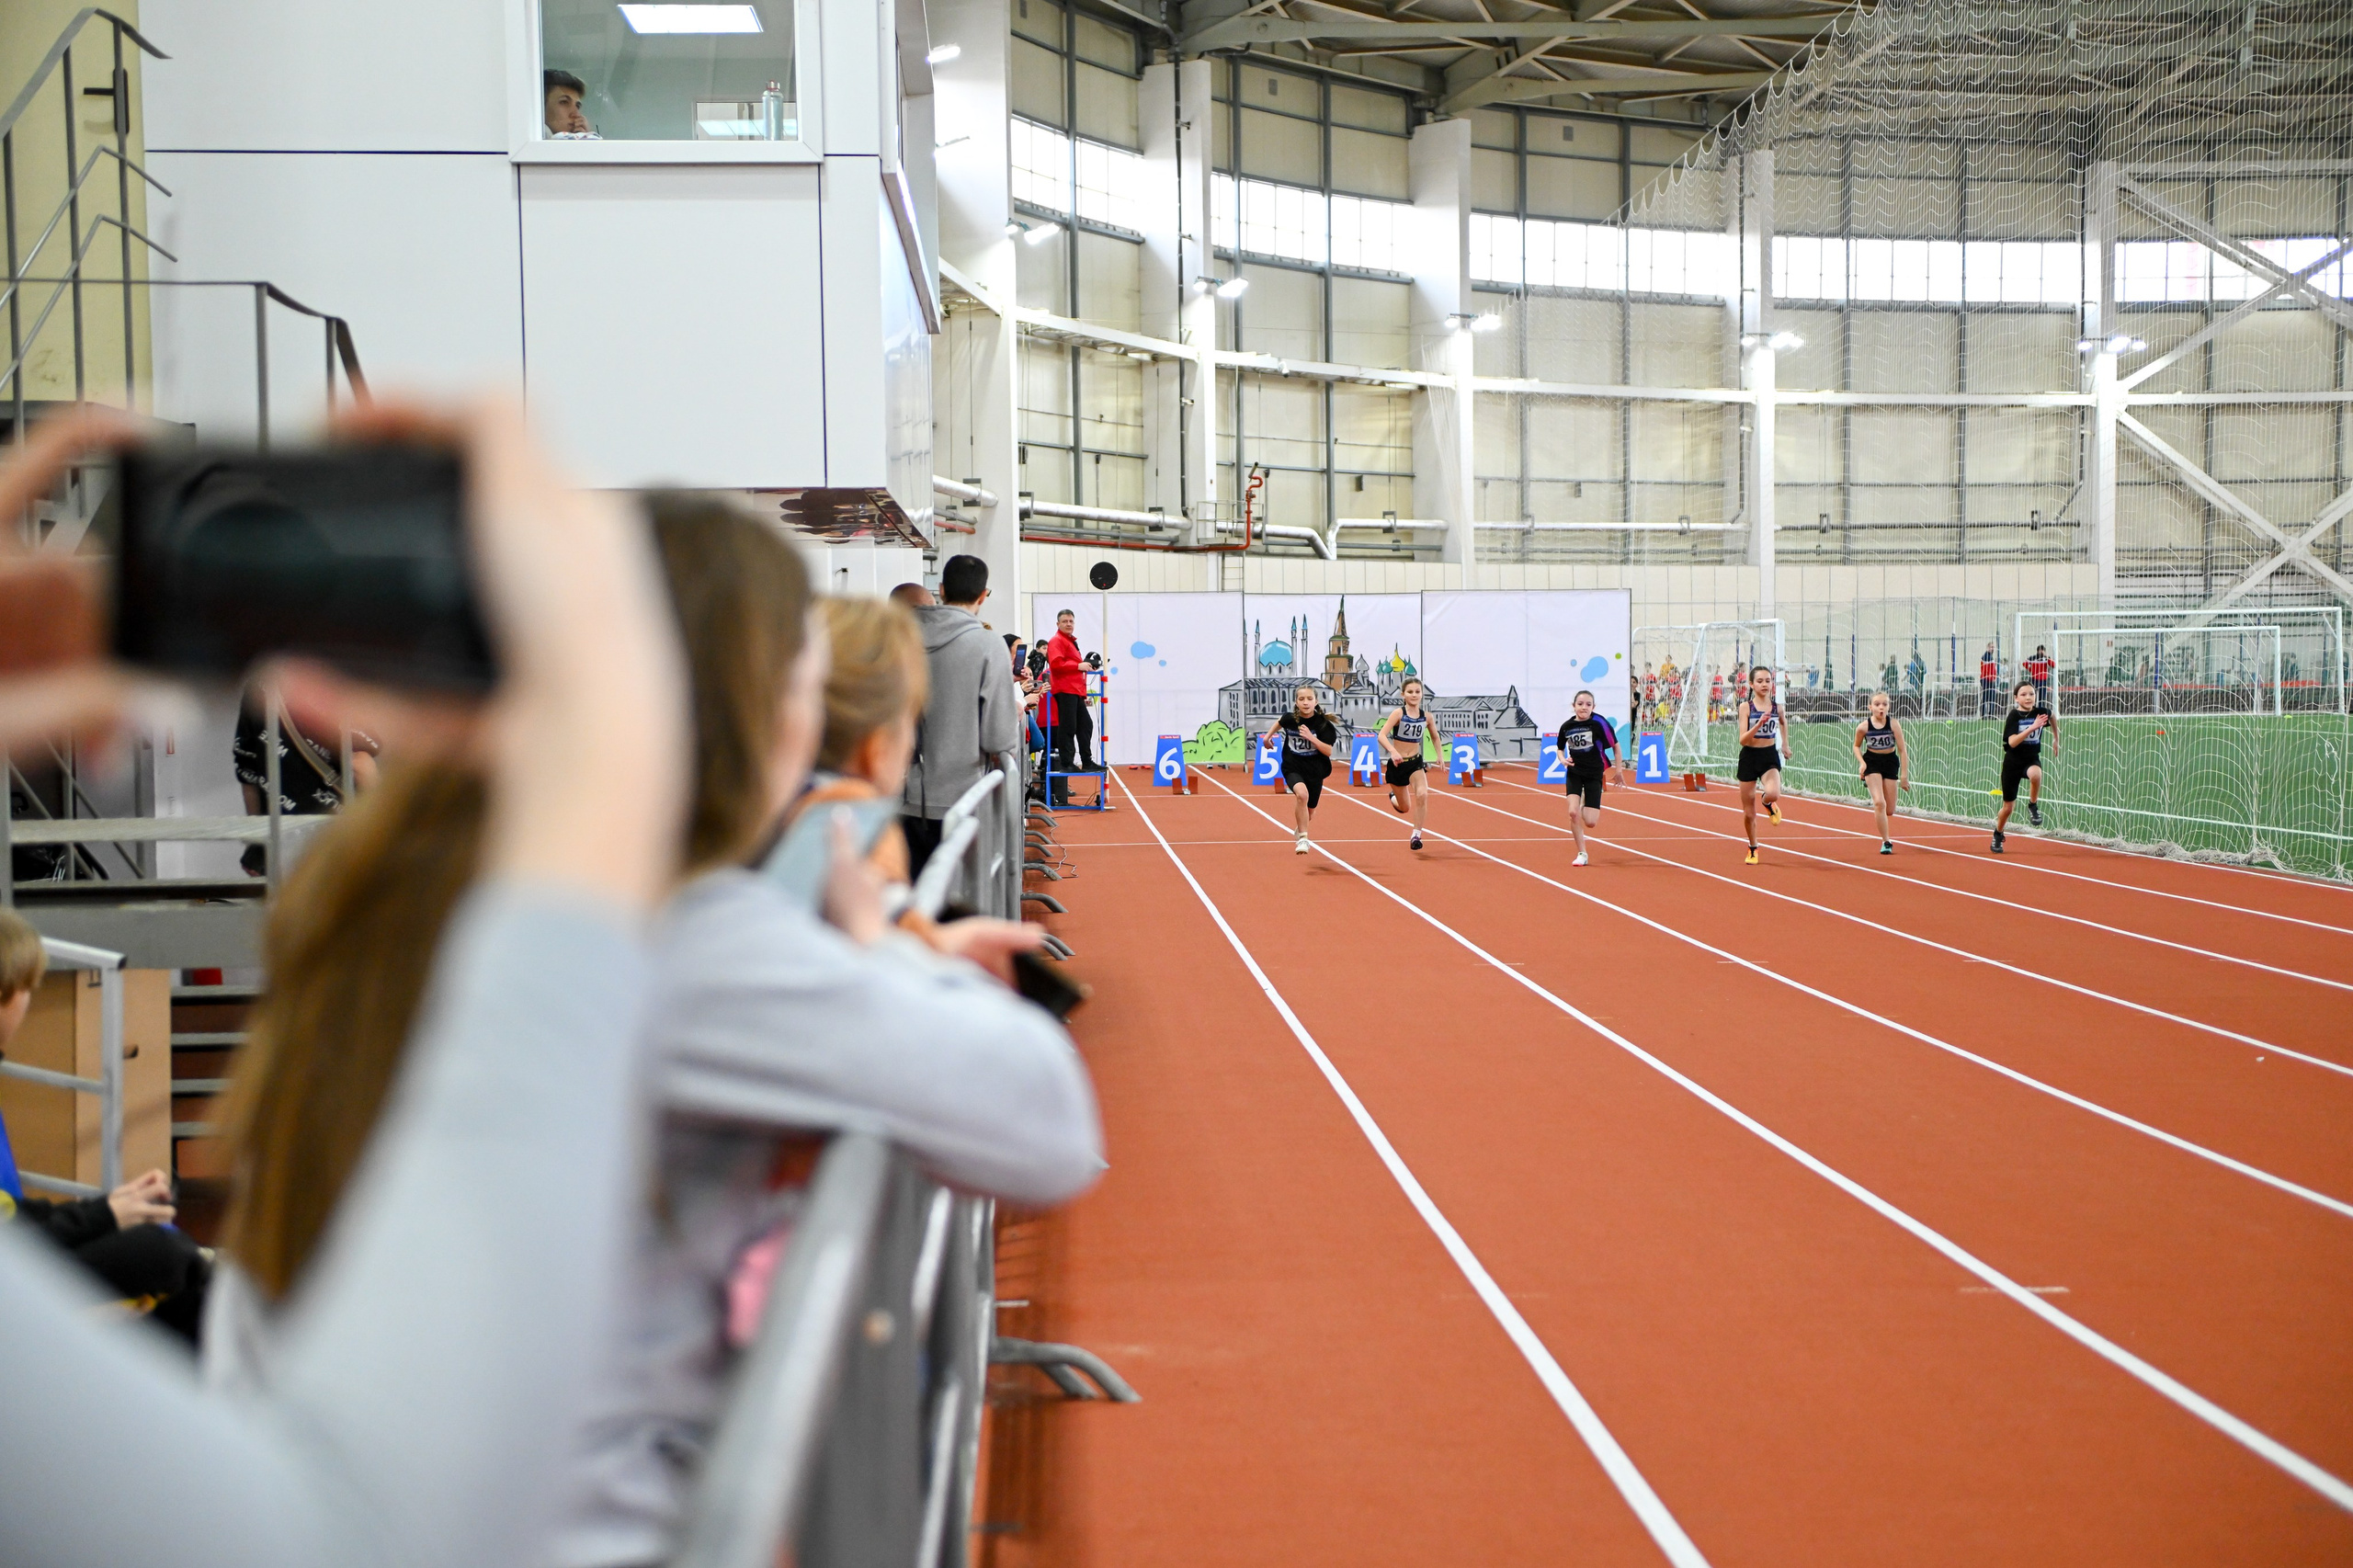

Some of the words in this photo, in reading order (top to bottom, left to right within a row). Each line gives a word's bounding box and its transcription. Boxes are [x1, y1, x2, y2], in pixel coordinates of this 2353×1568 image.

[1292, 737, 1312, 750] 120
[1403, 723, 1423, 737] 219
[1870, 736, 1891, 746] 240
[1159, 747, 1181, 780] 6
[1259, 746, 1279, 779] 5
[1354, 745, 1377, 778] 4
[1454, 745, 1476, 778] 3
[1542, 745, 1567, 778] 2
[1642, 744, 1662, 778] 1
